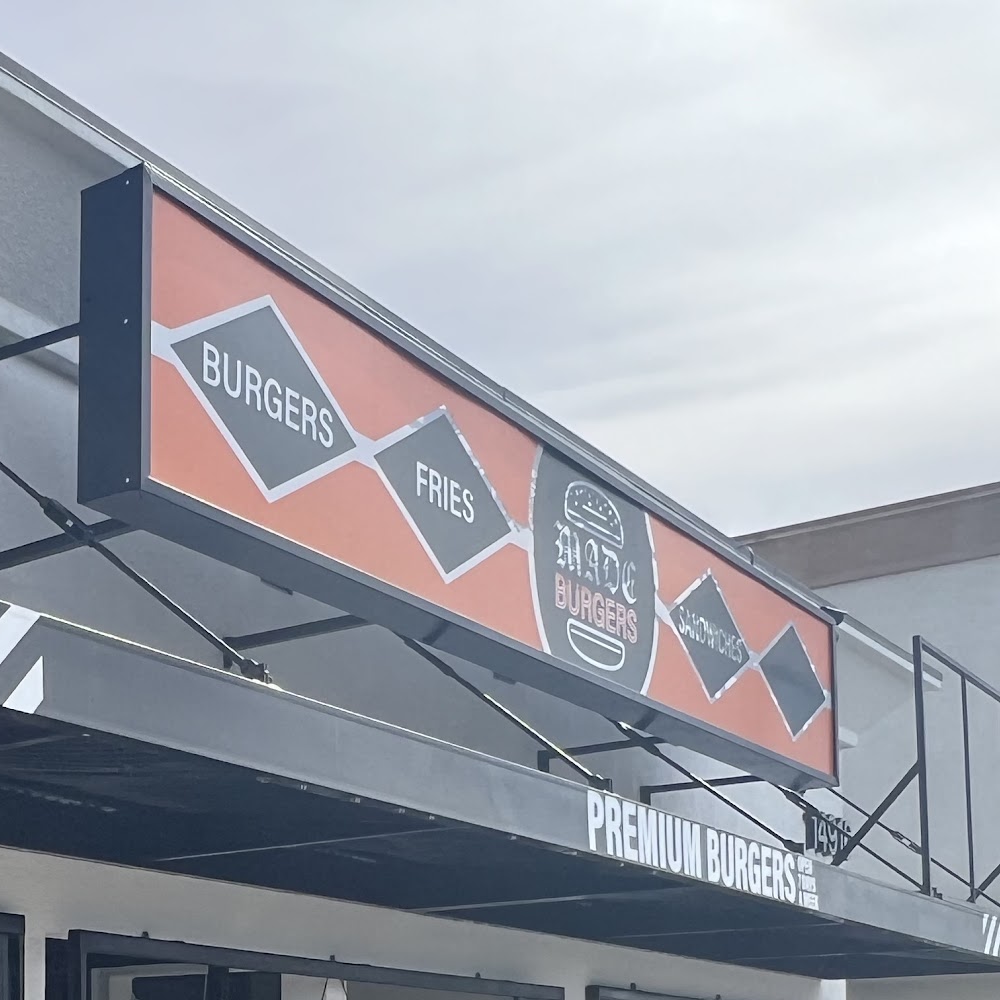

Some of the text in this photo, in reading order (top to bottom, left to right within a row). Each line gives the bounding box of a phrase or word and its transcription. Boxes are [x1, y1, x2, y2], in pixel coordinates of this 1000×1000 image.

[202, 340, 334, 448] BURGERS
[415, 460, 475, 523] FRIES
[553, 519, 637, 604] MADE
[554, 572, 638, 645] BURGERS
[678, 605, 743, 664] SANDWICHES
[587, 788, 797, 905] PREMIUM BURGERS
